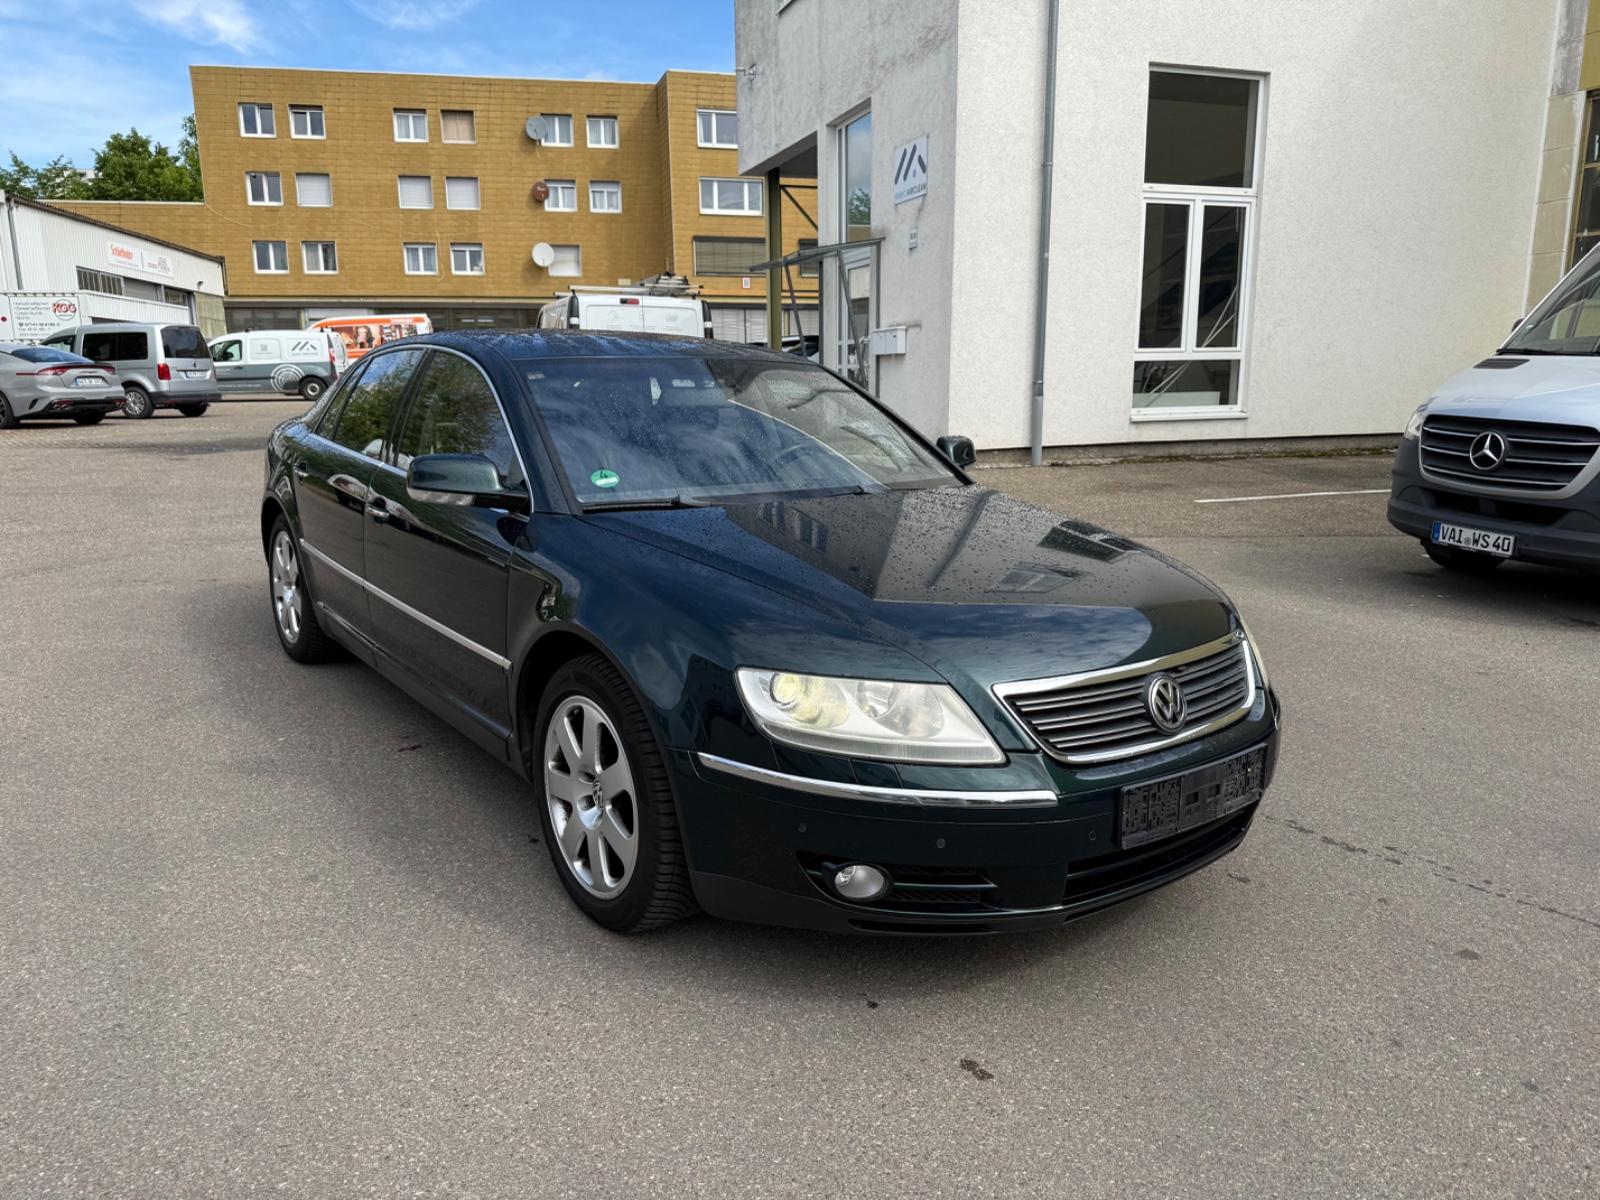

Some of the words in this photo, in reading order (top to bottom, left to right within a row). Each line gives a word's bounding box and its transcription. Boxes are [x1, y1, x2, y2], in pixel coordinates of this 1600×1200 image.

[1441, 526, 1463, 544] VAI
[1472, 531, 1490, 549] WS
[1492, 536, 1510, 552] 40
